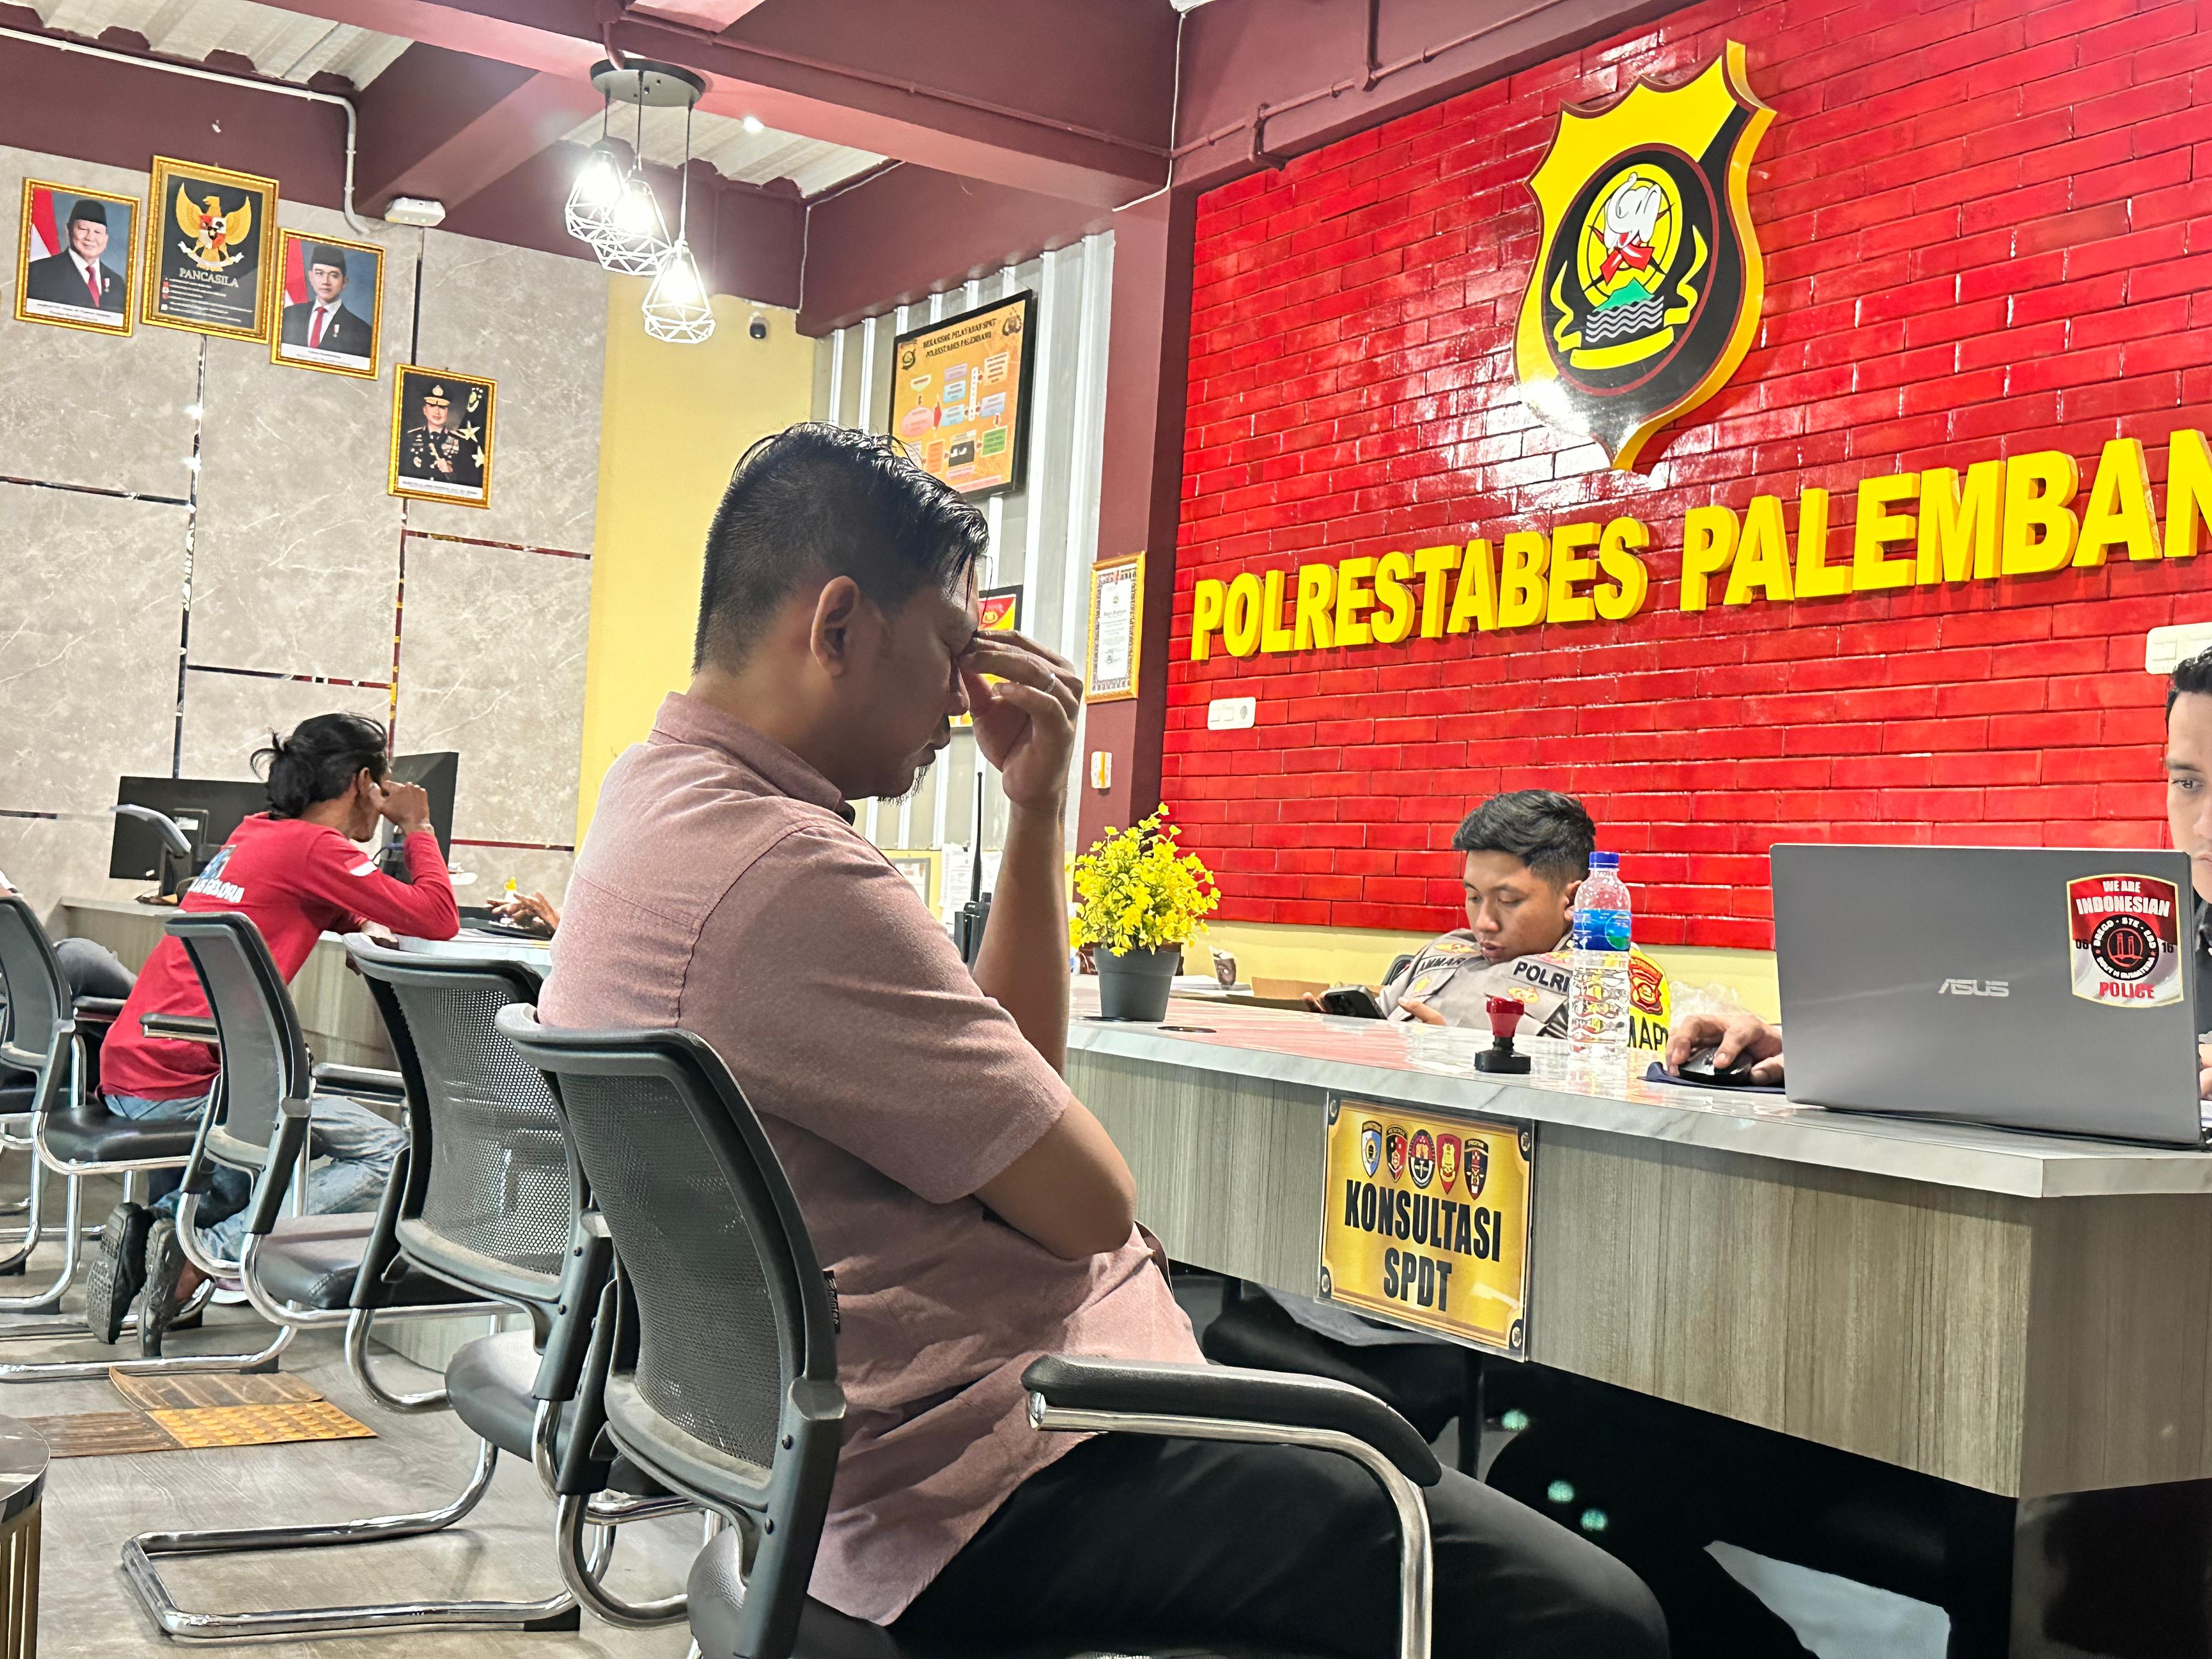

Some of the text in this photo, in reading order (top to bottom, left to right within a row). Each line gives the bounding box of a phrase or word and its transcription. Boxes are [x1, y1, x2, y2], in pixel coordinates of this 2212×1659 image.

[179, 267, 239, 287] PANCASILA
[1190, 516, 1650, 661] POLRESTABES
[2102, 880, 2141, 893] WE ARE
[2075, 895, 2170, 917] INDONESIAN
[1513, 961, 1571, 992] POLRI
[1938, 978, 2009, 997] ASUS
[2098, 981, 2155, 999] POLICE
[1345, 1179, 1501, 1262] KONSULTASI
[1384, 1247, 1452, 1312] SPDT
